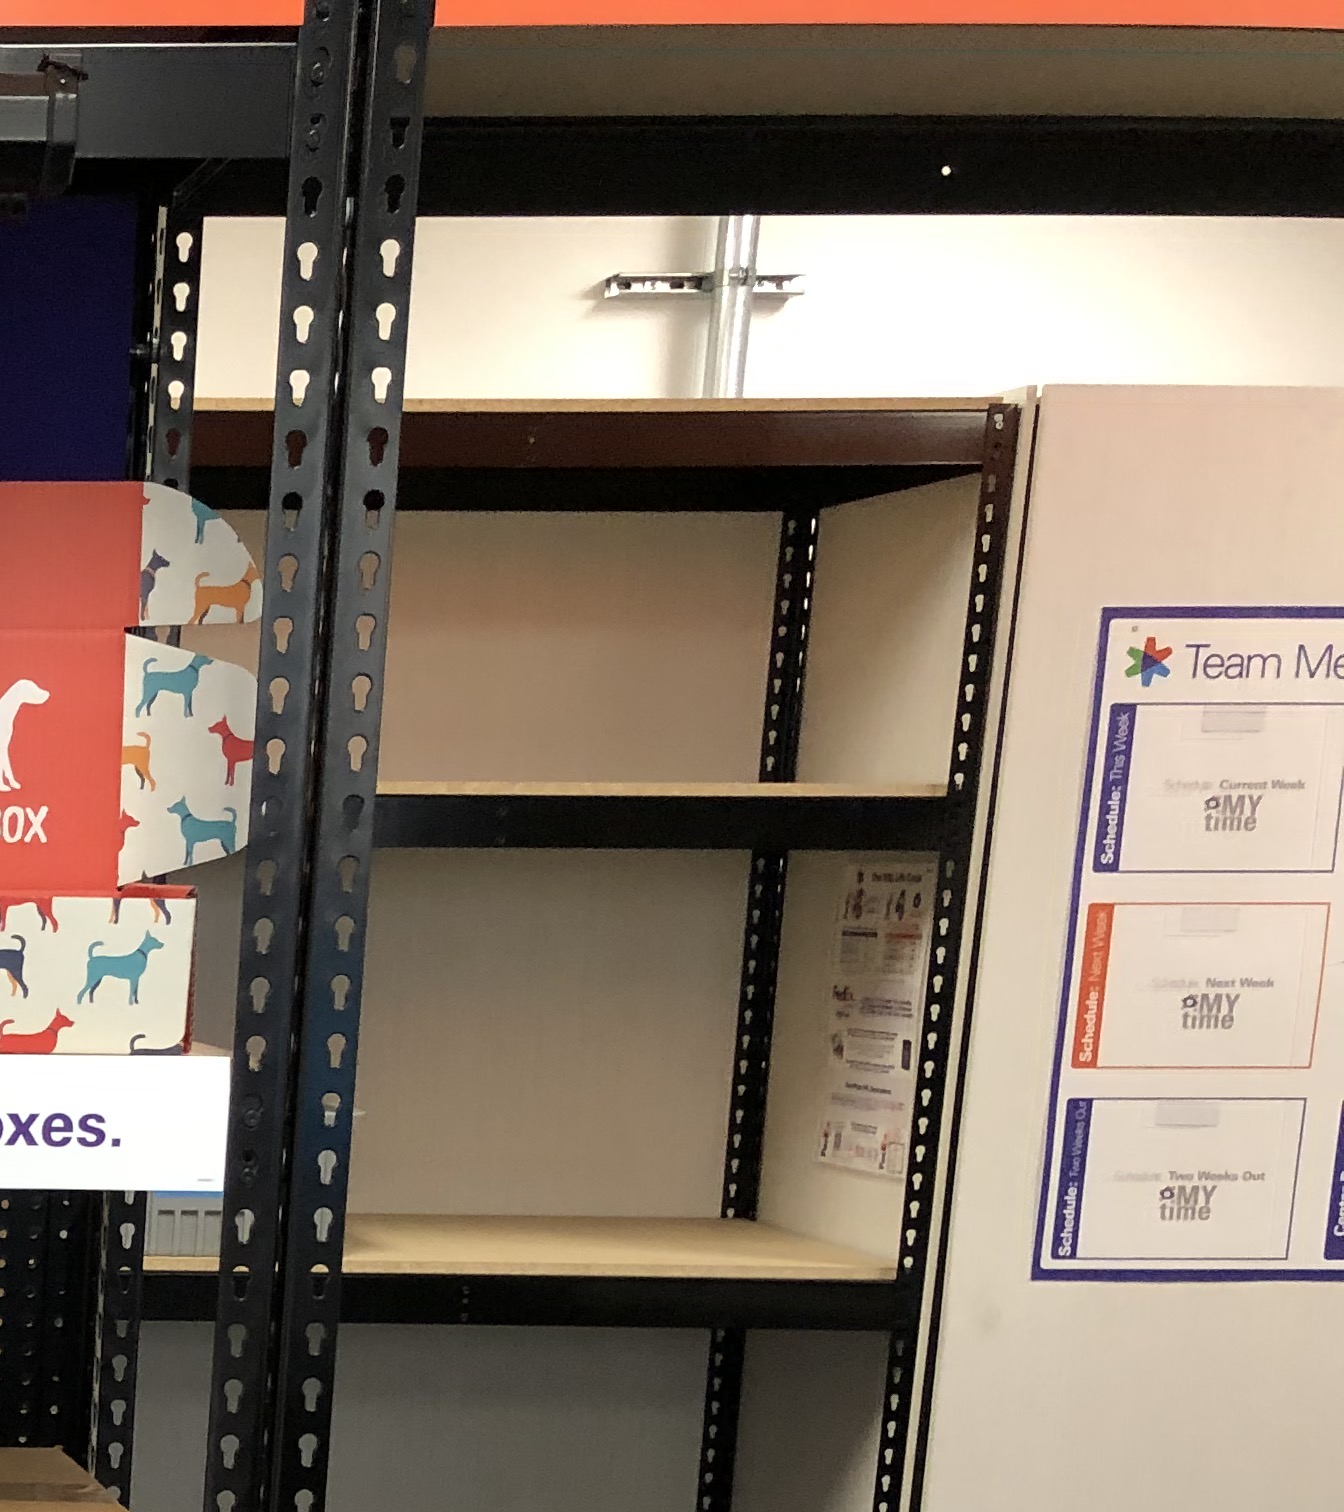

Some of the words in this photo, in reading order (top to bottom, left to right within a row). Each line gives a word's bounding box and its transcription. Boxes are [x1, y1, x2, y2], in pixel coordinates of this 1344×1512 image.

[1185, 643, 1282, 680] Team
[1111, 711, 1130, 752] Week
[1109, 754, 1126, 781] This
[1218, 779, 1268, 790] Current
[1271, 779, 1306, 790] Week
[1100, 785, 1122, 865] Schedule:
[1204, 812, 1258, 832] time
[1091, 909, 1108, 948] Week
[1088, 950, 1104, 982] Next
[1205, 977, 1236, 988] Next
[1239, 977, 1275, 988] Week
[1079, 986, 1099, 1062] Schedule:
[1181, 1011, 1235, 1030] time
[1168, 1170, 1194, 1181] Two
[1197, 1170, 1239, 1181] Weeks
[1242, 1170, 1266, 1181] Out
[1058, 1181, 1078, 1257] Schedule:
[1159, 1202, 1212, 1221] time
